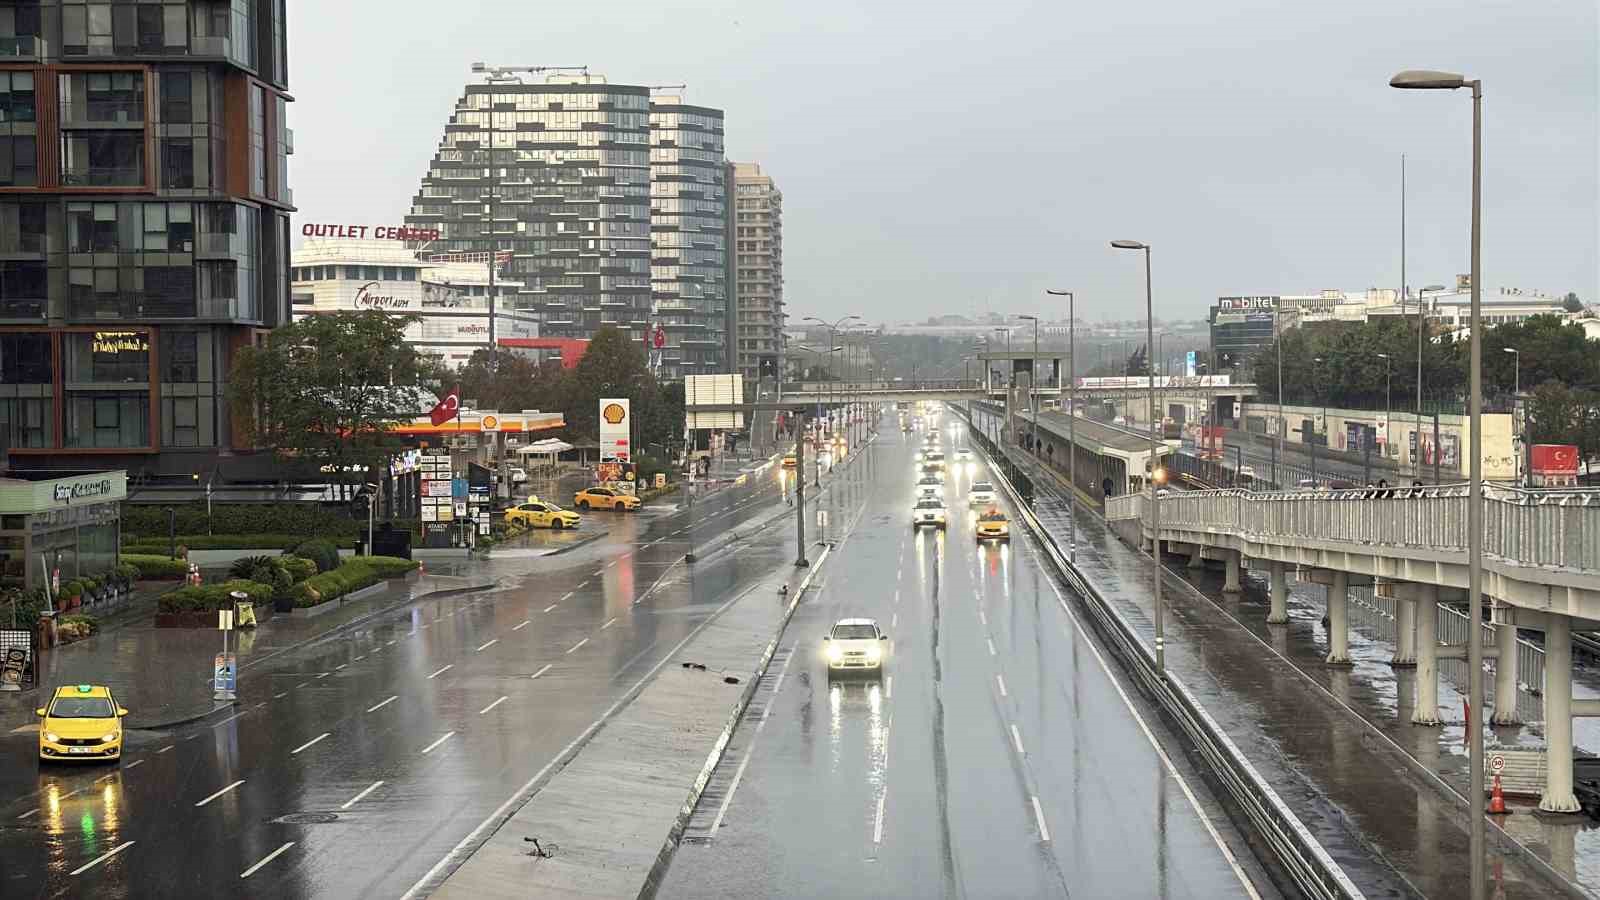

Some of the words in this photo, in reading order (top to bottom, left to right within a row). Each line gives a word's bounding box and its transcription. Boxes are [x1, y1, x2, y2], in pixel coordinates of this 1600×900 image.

[302, 223, 368, 239] OUTLET
[375, 226, 440, 241] CENTER
[361, 292, 393, 306] Airport
